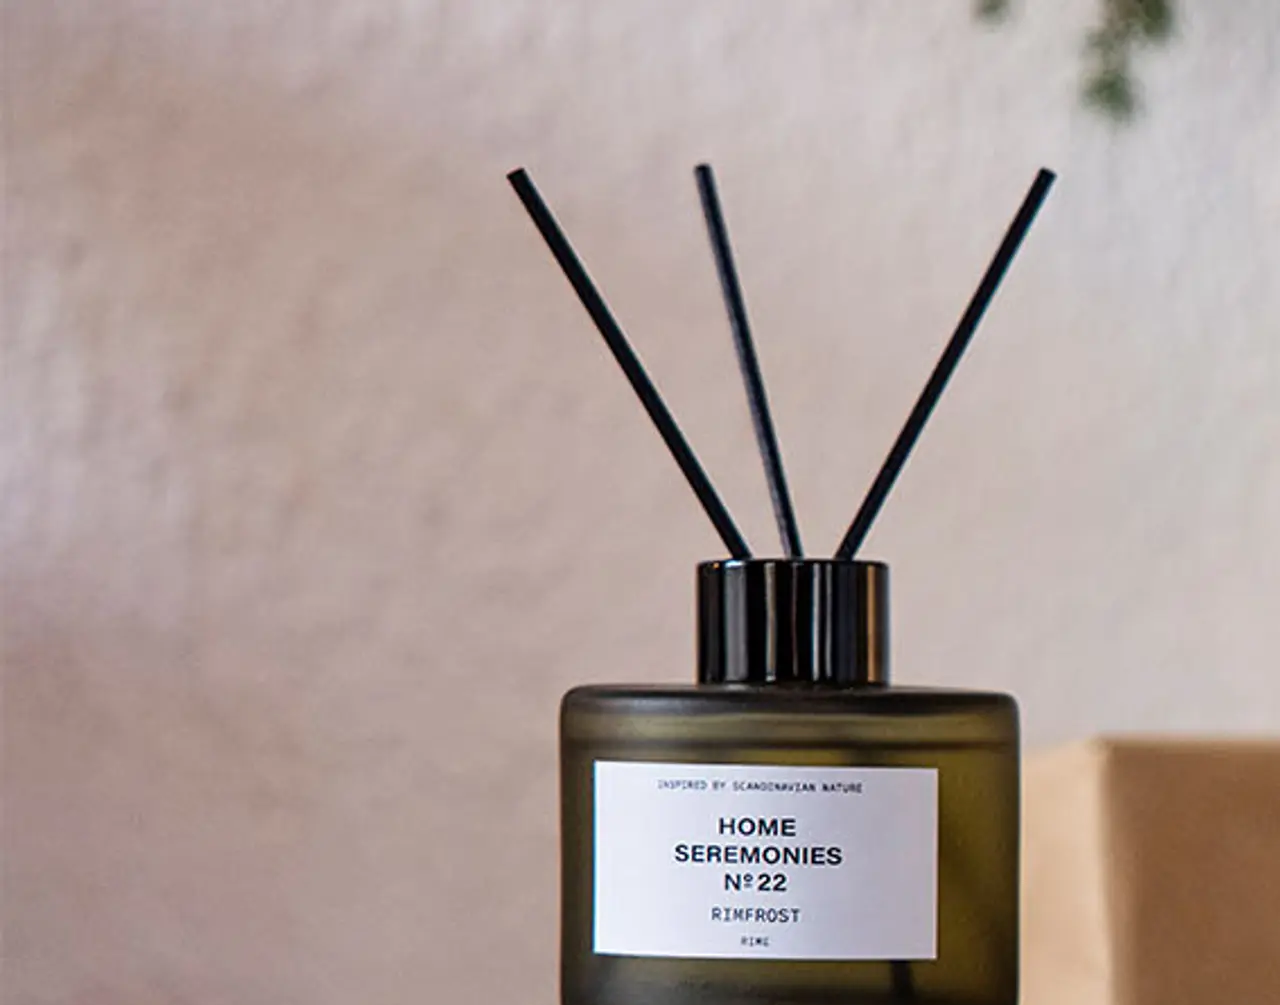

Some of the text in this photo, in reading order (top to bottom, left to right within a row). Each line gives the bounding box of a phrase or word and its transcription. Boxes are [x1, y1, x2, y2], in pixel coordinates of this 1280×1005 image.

[658, 780, 862, 793] INSPIRED BY SCANDINAVIAN NATURE
[719, 818, 796, 837] HOME
[675, 844, 842, 865] SEREMONIES
[712, 908, 800, 923] RIMFROST
